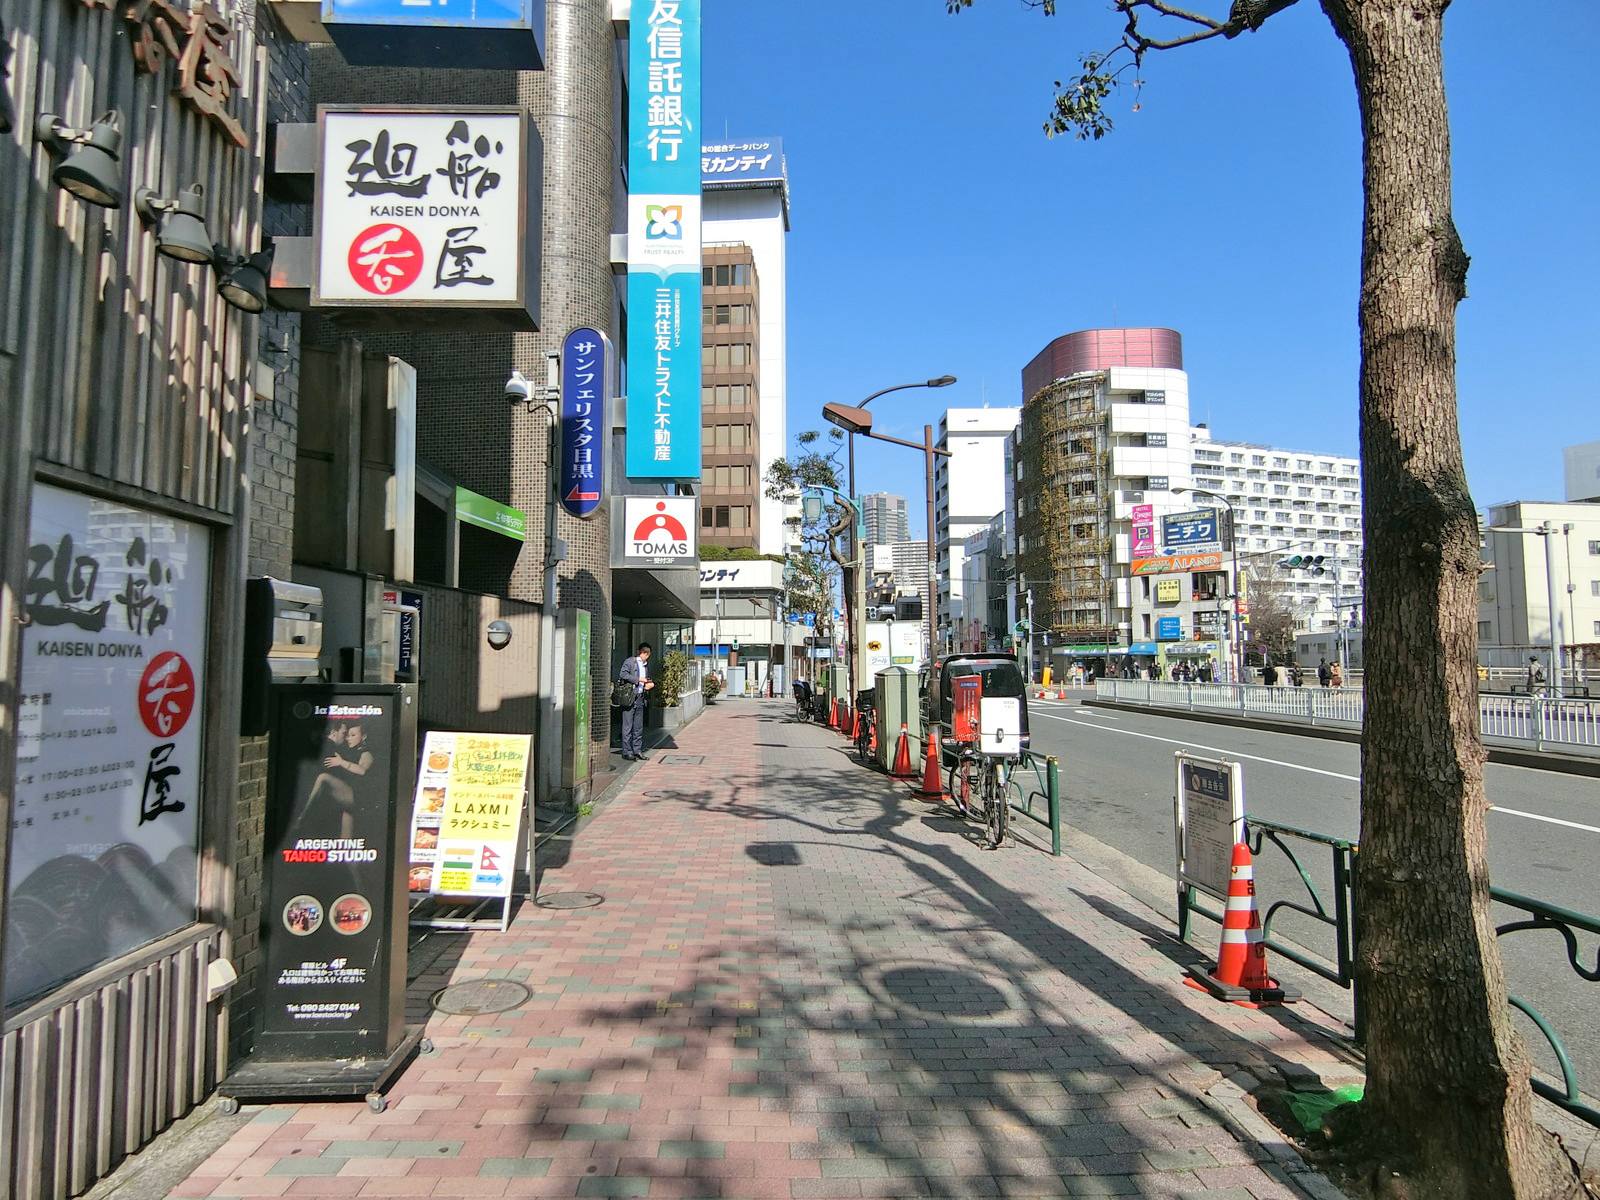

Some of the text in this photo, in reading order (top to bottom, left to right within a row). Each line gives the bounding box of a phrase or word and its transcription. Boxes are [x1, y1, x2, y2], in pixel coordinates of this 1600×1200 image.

[345, 121, 503, 199] 廻船
[370, 206, 480, 217] KAISEN DONYA
[654, 288, 672, 461] 三井住友トラスト不動産
[572, 341, 597, 479] サンフェリスタ目黒
[1167, 523, 1211, 539] ニチワ
[633, 543, 687, 555] TOMAS
[402, 612, 412, 667] ンチメニュー
[38, 641, 143, 658] KAISEN DONYA
[315, 704, 383, 715] la Estación
[454, 803, 509, 816] LAXMI
[450, 818, 511, 832] ラクシュミー
[295, 839, 365, 850] ARGENTINE
[283, 850, 377, 863] TANGO STUDIO
[330, 958, 348, 969] 4F
